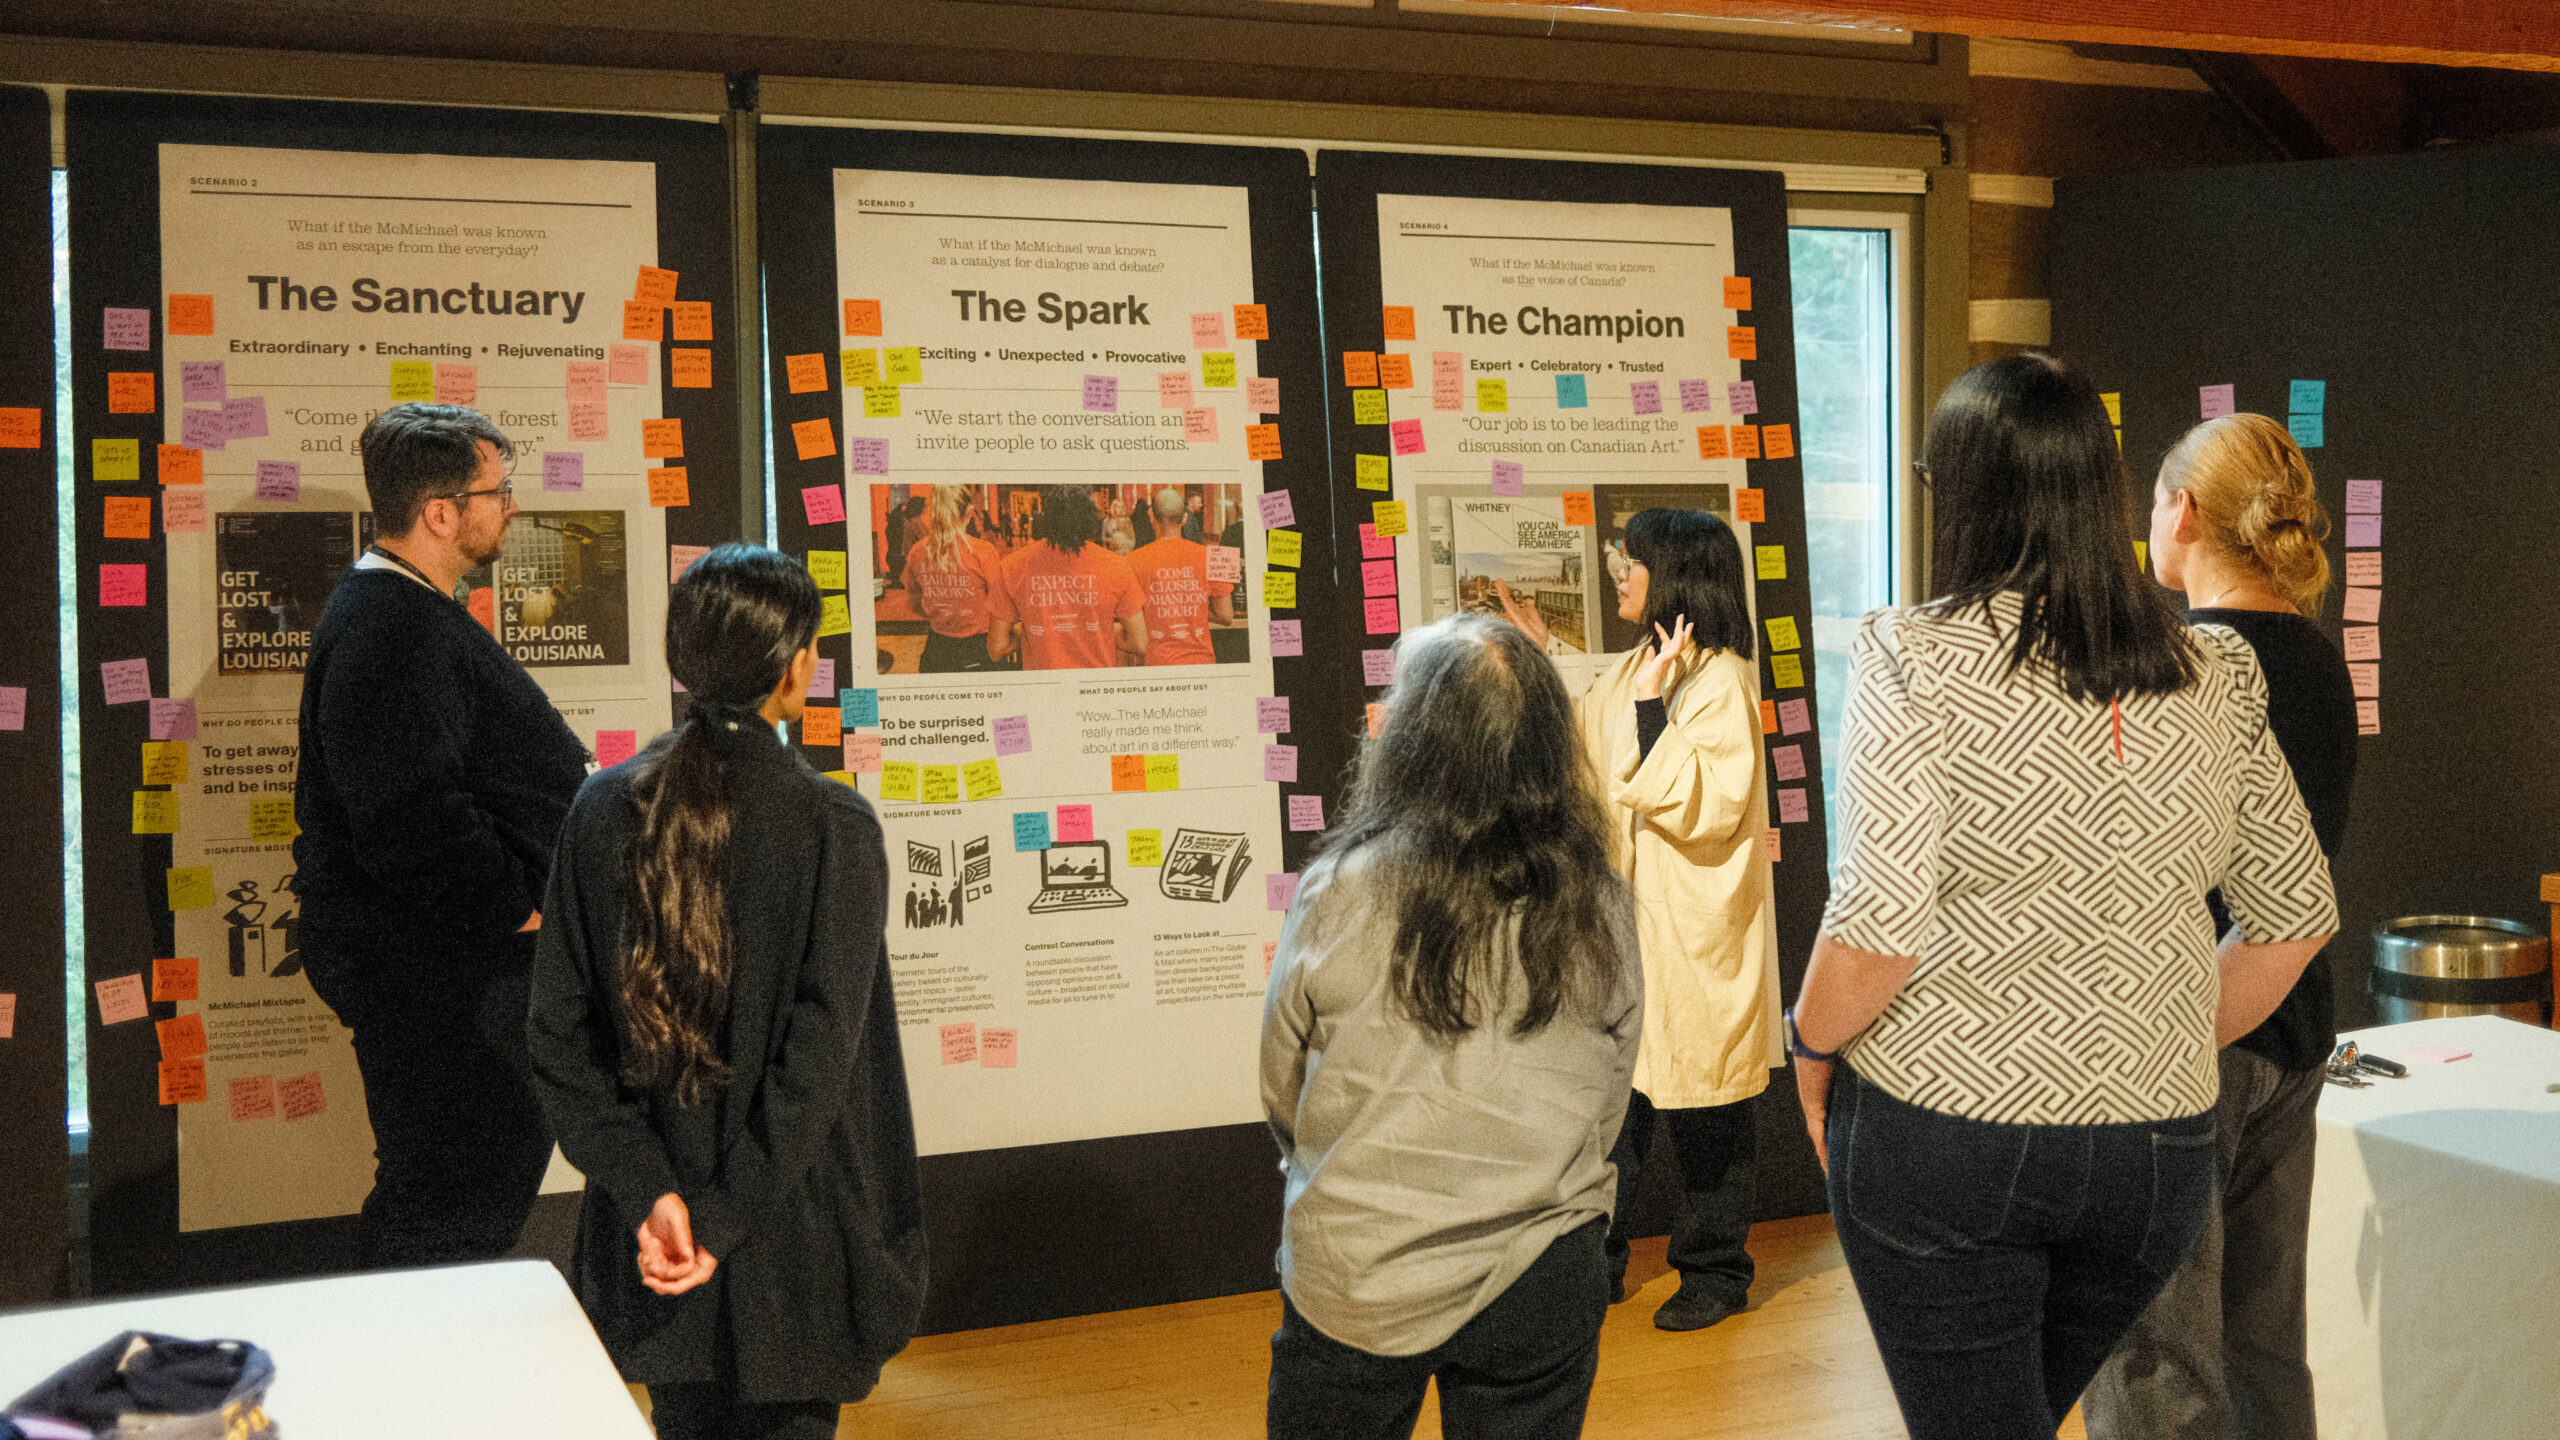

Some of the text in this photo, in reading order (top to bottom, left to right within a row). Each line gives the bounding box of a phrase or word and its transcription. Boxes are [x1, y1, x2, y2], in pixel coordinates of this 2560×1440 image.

[189, 176, 257, 186] SCENARIO 2
[857, 198, 906, 207] SCENARIO
[286, 218, 546, 238] What if the McMichael was known
[295, 239, 538, 258] as an escape from the everyday?
[938, 237, 1156, 256] What if the McMichael was known
[930, 255, 1165, 272] as a catalyst for dialogue and debate?
[1469, 257, 1656, 273] What if the McMichael was known
[1501, 274, 1626, 287] as the voice of Canada?
[247, 275, 337, 311] The
[351, 278, 584, 324] Sanctuary
[951, 289, 1149, 331] The Spark
[1442, 304, 1684, 343] The Champion
[228, 339, 604, 359] Extraordinary Enchanting Rejuvenating
[918, 346, 1186, 363] Exciting Unexpected Provocative
[1469, 358, 1664, 374] Expert Celebratory Trusted
[285, 408, 358, 428] “Come
[498, 409, 558, 428] forest
[914, 409, 1155, 426] “We start the conversation
[1461, 415, 1678, 434] “Our job is to be leading the
[300, 434, 344, 454] and
[916, 432, 1190, 453] invite people to ask questions.
[1457, 438, 1685, 453] discussion on Canadian Art.”
[1465, 502, 1510, 512] WHITNEY
[1517, 521, 1559, 531] YOU CAN
[1517, 531, 1581, 540] SEE AMERICA
[1518, 540, 1573, 549] FROM HERE
[221, 571, 258, 587] GET
[1156, 567, 1194, 580] COME
[1031, 574, 1097, 591] EXPECT
[1150, 580, 1203, 593] CLOSER,
[221, 592, 272, 608] LOST
[504, 586, 551, 603] LOST
[1029, 591, 1099, 607] CHANGE
[1148, 592, 1208, 605] ABANDON
[504, 606, 517, 622] &
[1157, 605, 1199, 618] DOUBT
[221, 612, 236, 628] &
[222, 630, 311, 648] EXPLORE
[505, 622, 587, 641] EXPLORE
[878, 695, 896, 703] WHY
[947, 692, 971, 700] COME
[1142, 707, 1207, 719] McMichael
[880, 716, 984, 730] To be surprised
[1081, 722, 1203, 738] really made me think
[880, 732, 990, 746] and challenged.
[1081, 735, 1240, 754] about art in a different way.”
[202, 742, 298, 760] To get away
[202, 761, 294, 776] stresses of
[203, 781, 258, 794] and be
[883, 808, 962, 818] SIGNATURE MOVES
[1024, 939, 1114, 951] Contrast Conversations
[890, 953, 908, 962] Tour
[208, 997, 306, 1010] McMichael Mixtapes
